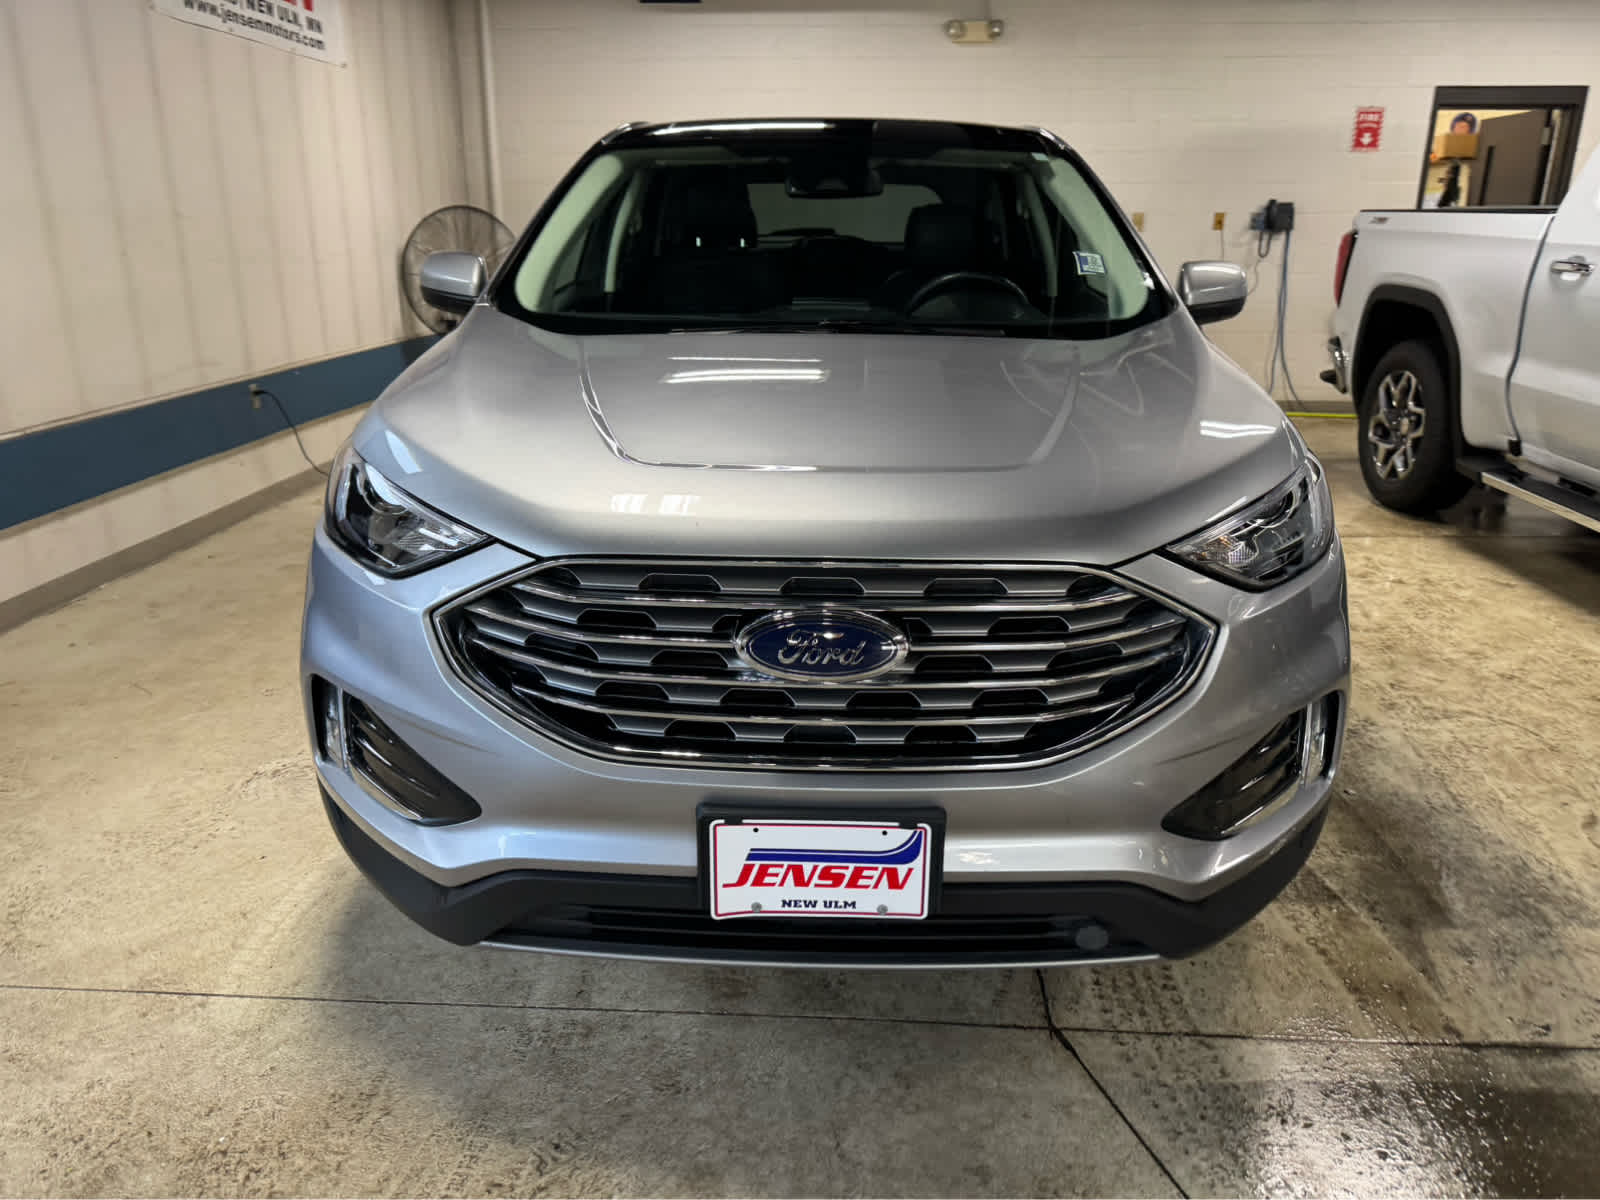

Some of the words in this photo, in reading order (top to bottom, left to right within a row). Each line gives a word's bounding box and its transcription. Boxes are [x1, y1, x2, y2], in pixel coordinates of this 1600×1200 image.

[777, 629, 867, 665] Ford
[722, 863, 914, 890] JENSEN
[781, 899, 818, 909] NEW
[823, 900, 857, 910] ULM
